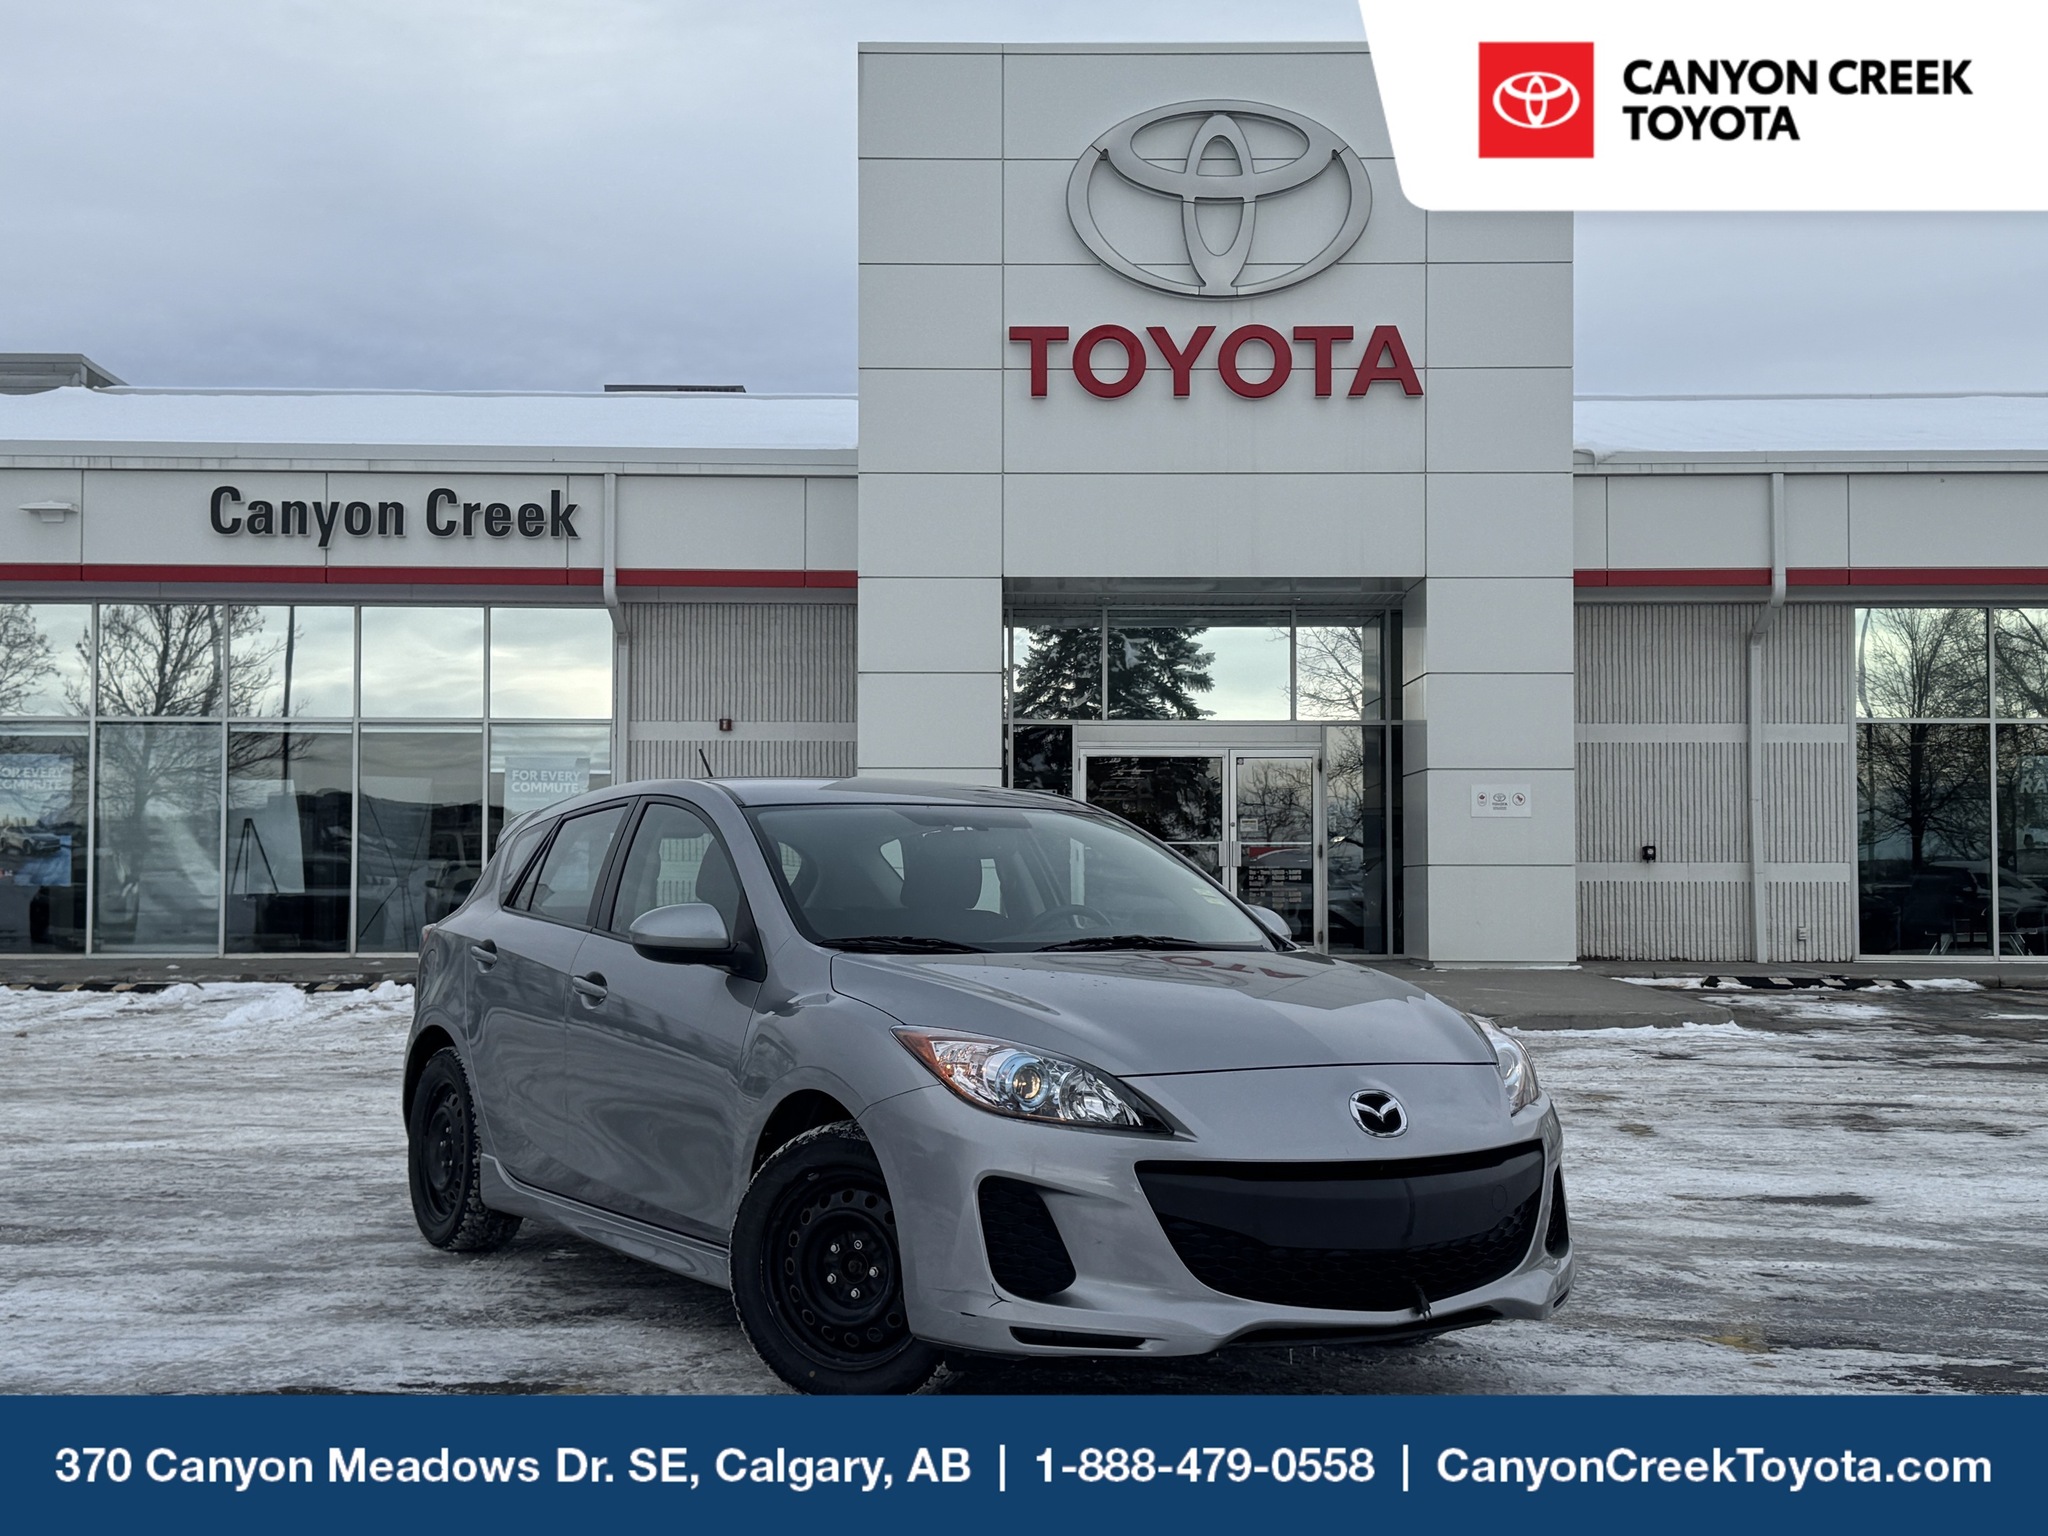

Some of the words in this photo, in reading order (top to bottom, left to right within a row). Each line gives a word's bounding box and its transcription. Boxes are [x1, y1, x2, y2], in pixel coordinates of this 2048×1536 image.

[1008, 324, 1424, 400] TOYOTA
[209, 485, 405, 548] Canyon
[425, 487, 580, 538] Creek
[0, 767, 21, 778] OR
[23, 767, 64, 778] EVERY
[512, 770, 538, 781] FOR
[541, 771, 581, 782] EVERY
[0, 779, 62, 790] OMMUTE
[511, 782, 579, 793] COMMUTE
